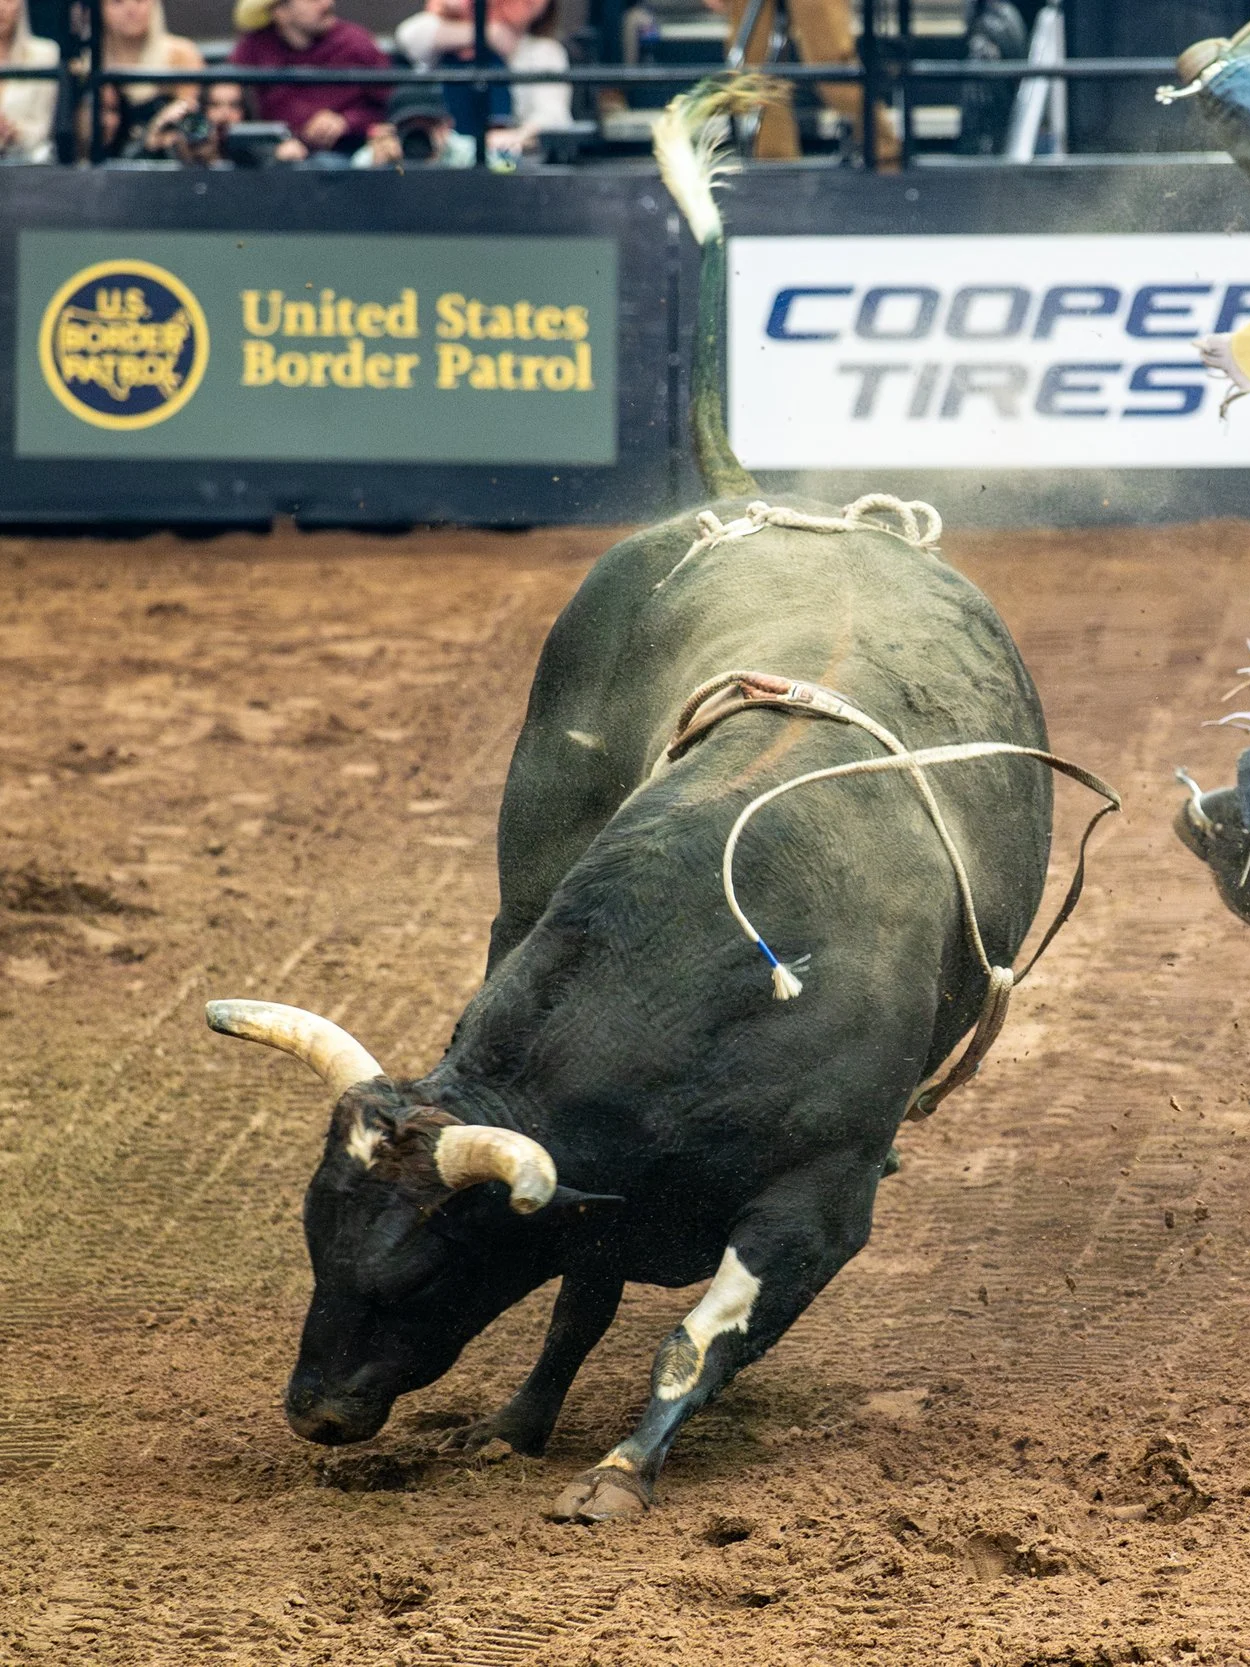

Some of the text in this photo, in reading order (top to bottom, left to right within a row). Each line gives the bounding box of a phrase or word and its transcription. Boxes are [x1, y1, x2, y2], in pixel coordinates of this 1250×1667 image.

[64, 321, 185, 351] BORDER
[240, 288, 589, 340] United States
[63, 354, 178, 388] PATROL
[241, 338, 594, 392] Border Patrol
[837, 362, 1206, 420] TIRES
